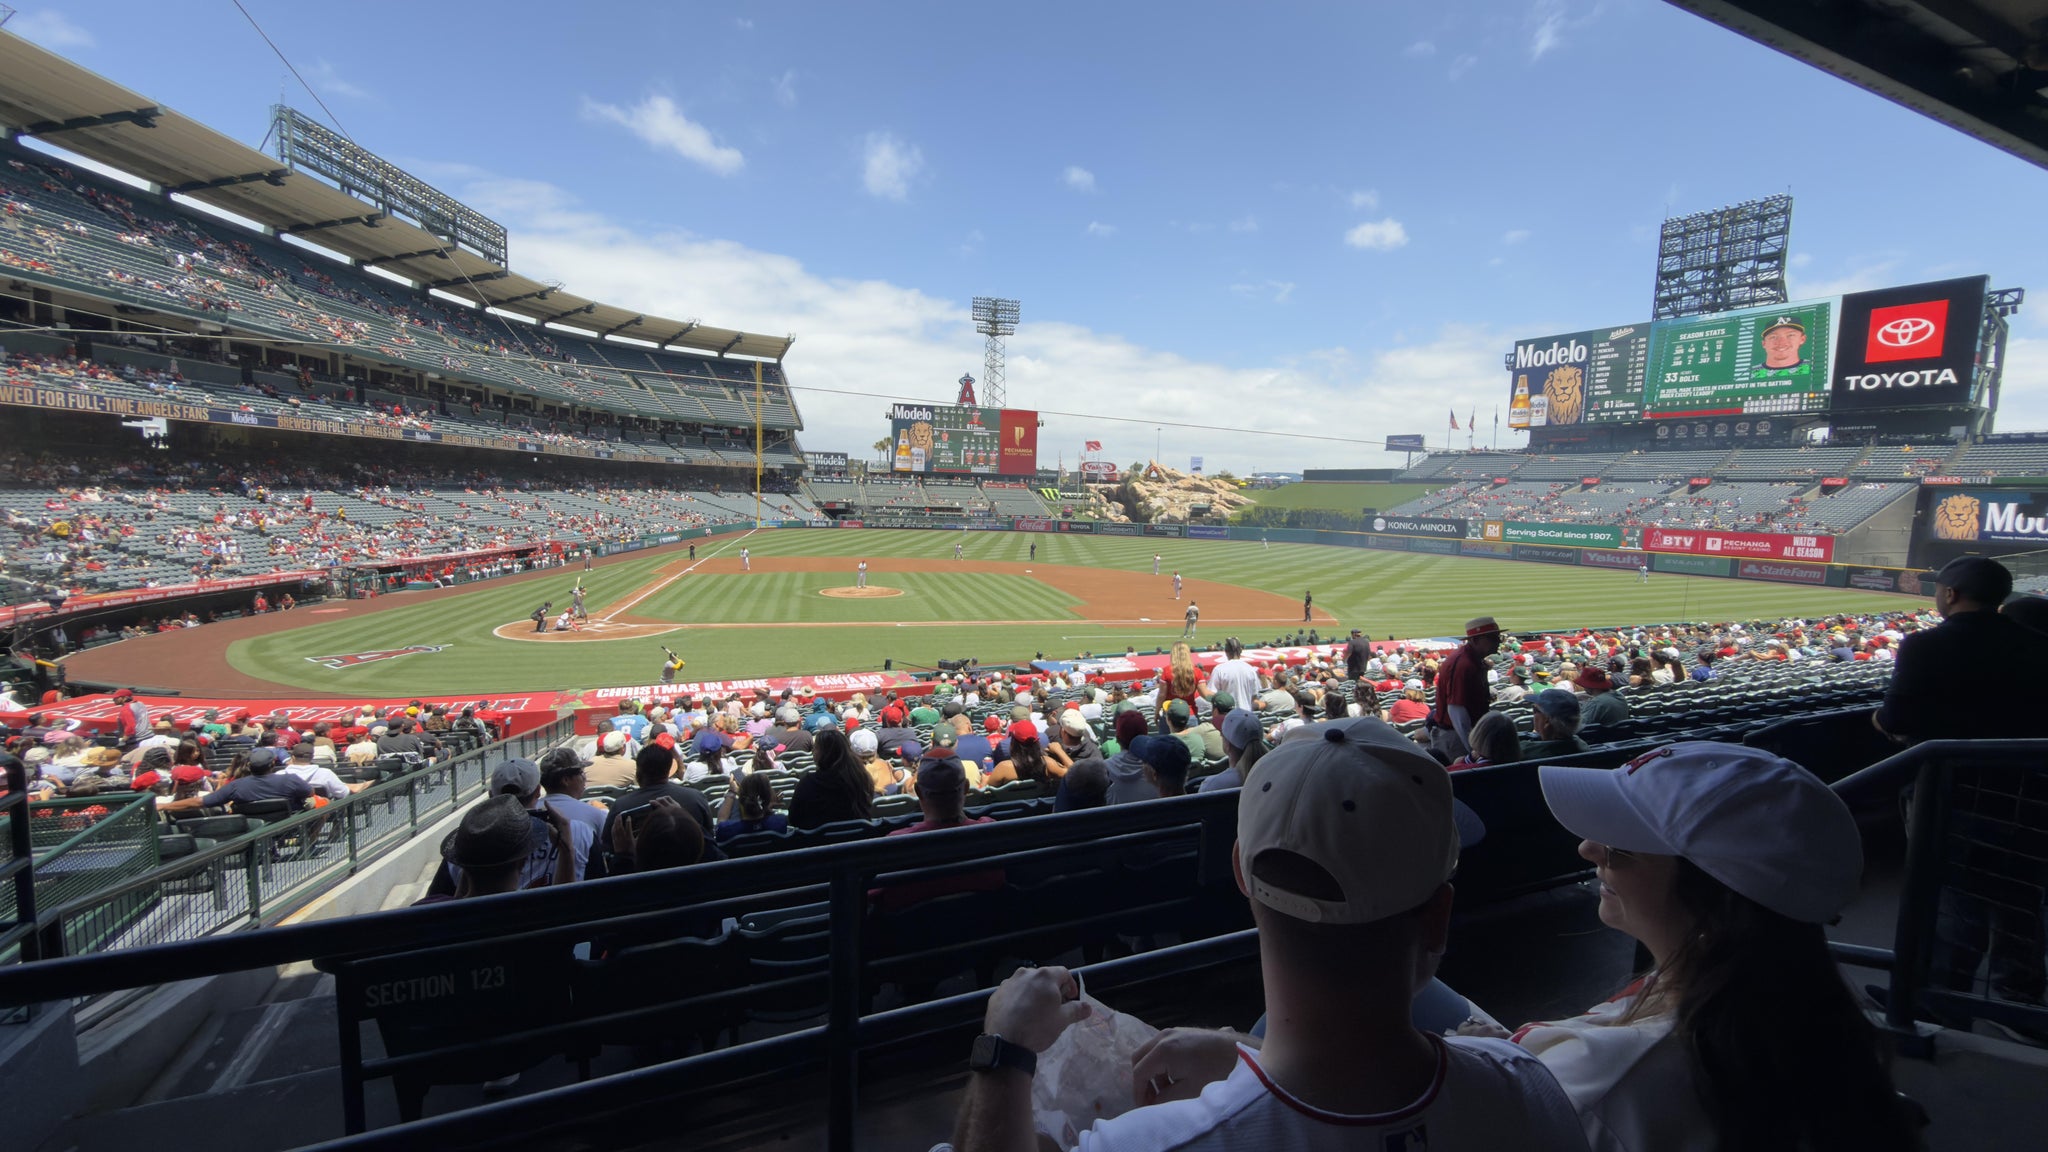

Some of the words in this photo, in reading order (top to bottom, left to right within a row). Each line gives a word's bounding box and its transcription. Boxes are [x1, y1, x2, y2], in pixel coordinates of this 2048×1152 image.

[1679, 331, 1705, 340] SEASON
[1705, 328, 1726, 337] STATS
[1515, 340, 1588, 369] Modelo
[1664, 372, 1678, 383] 33
[1845, 368, 1958, 391] TOYOTA
[36, 389, 64, 407] FOR
[68, 393, 134, 414] FULL-TIME
[137, 400, 180, 417] ANGELS
[183, 406, 209, 421] FANS
[1604, 400, 1614, 408] 61
[231, 412, 258, 425] Modelo
[894, 405, 932, 420] Modelo
[278, 416, 311, 430] BREWED
[312, 419, 327, 431] FOR
[328, 420, 364, 435] FULL-TIME
[816, 454, 846, 466] Modelo
[1388, 522, 1418, 531] KONICA
[1420, 523, 1457, 533] MINOLTA
[1507, 528, 1536, 538] Serving
[1538, 530, 1562, 538] SoCal
[1564, 531, 1587, 539] since
[1589, 532, 1614, 541] 1907.
[1724, 540, 1771, 548] PECHANGA
[1793, 536, 1816, 547] WATCH
[1783, 546, 1795, 557] ALL
[1797, 547, 1824, 559] SEASON
[1760, 564, 1821, 579] StateFarm
[596, 683, 701, 698] CHRISTMAS
[700, 681, 722, 691] IN
[728, 679, 769, 690] JUNE
[366, 973, 455, 1007] SECTION
[471, 966, 505, 991] 123
